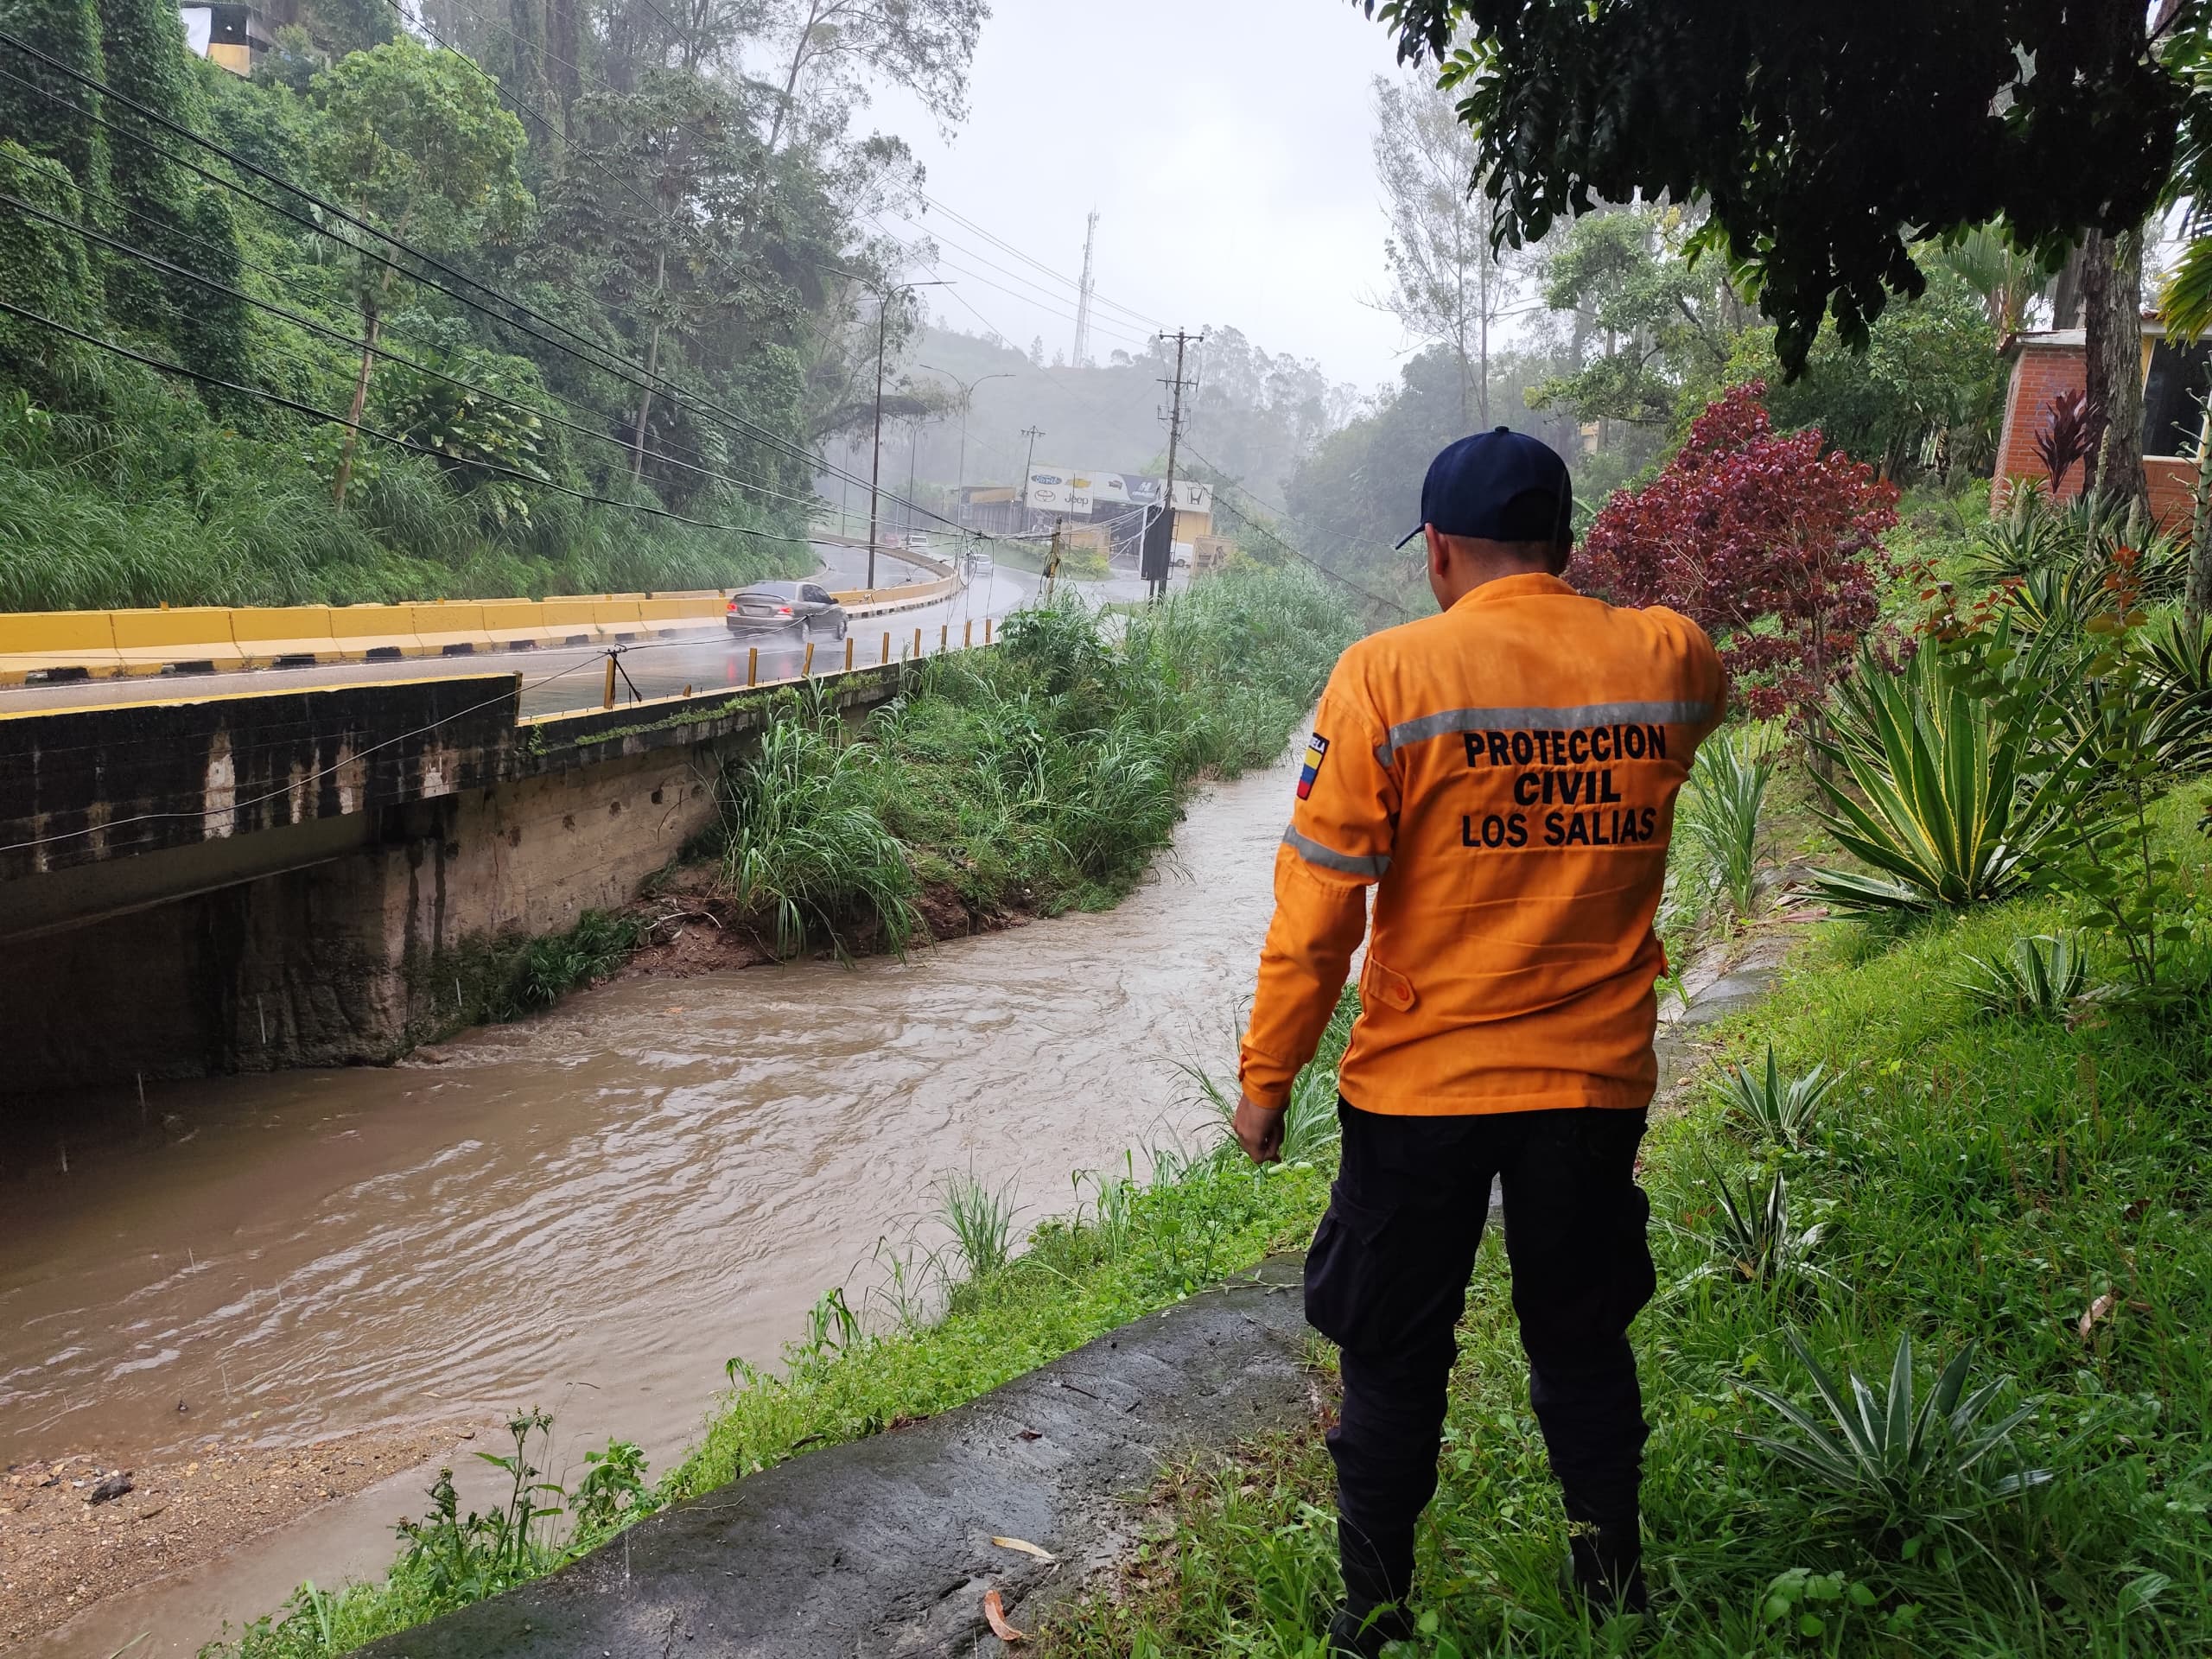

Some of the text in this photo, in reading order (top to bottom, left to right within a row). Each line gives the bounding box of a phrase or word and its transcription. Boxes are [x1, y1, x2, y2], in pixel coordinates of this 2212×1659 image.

[1036, 475, 1058, 485] Ford
[1064, 493, 1089, 508] Jeep
[1463, 724, 1666, 768] PROTECCION
[1513, 769, 1622, 806] CIVIL
[1462, 807, 1657, 849] LOS SALIAS
